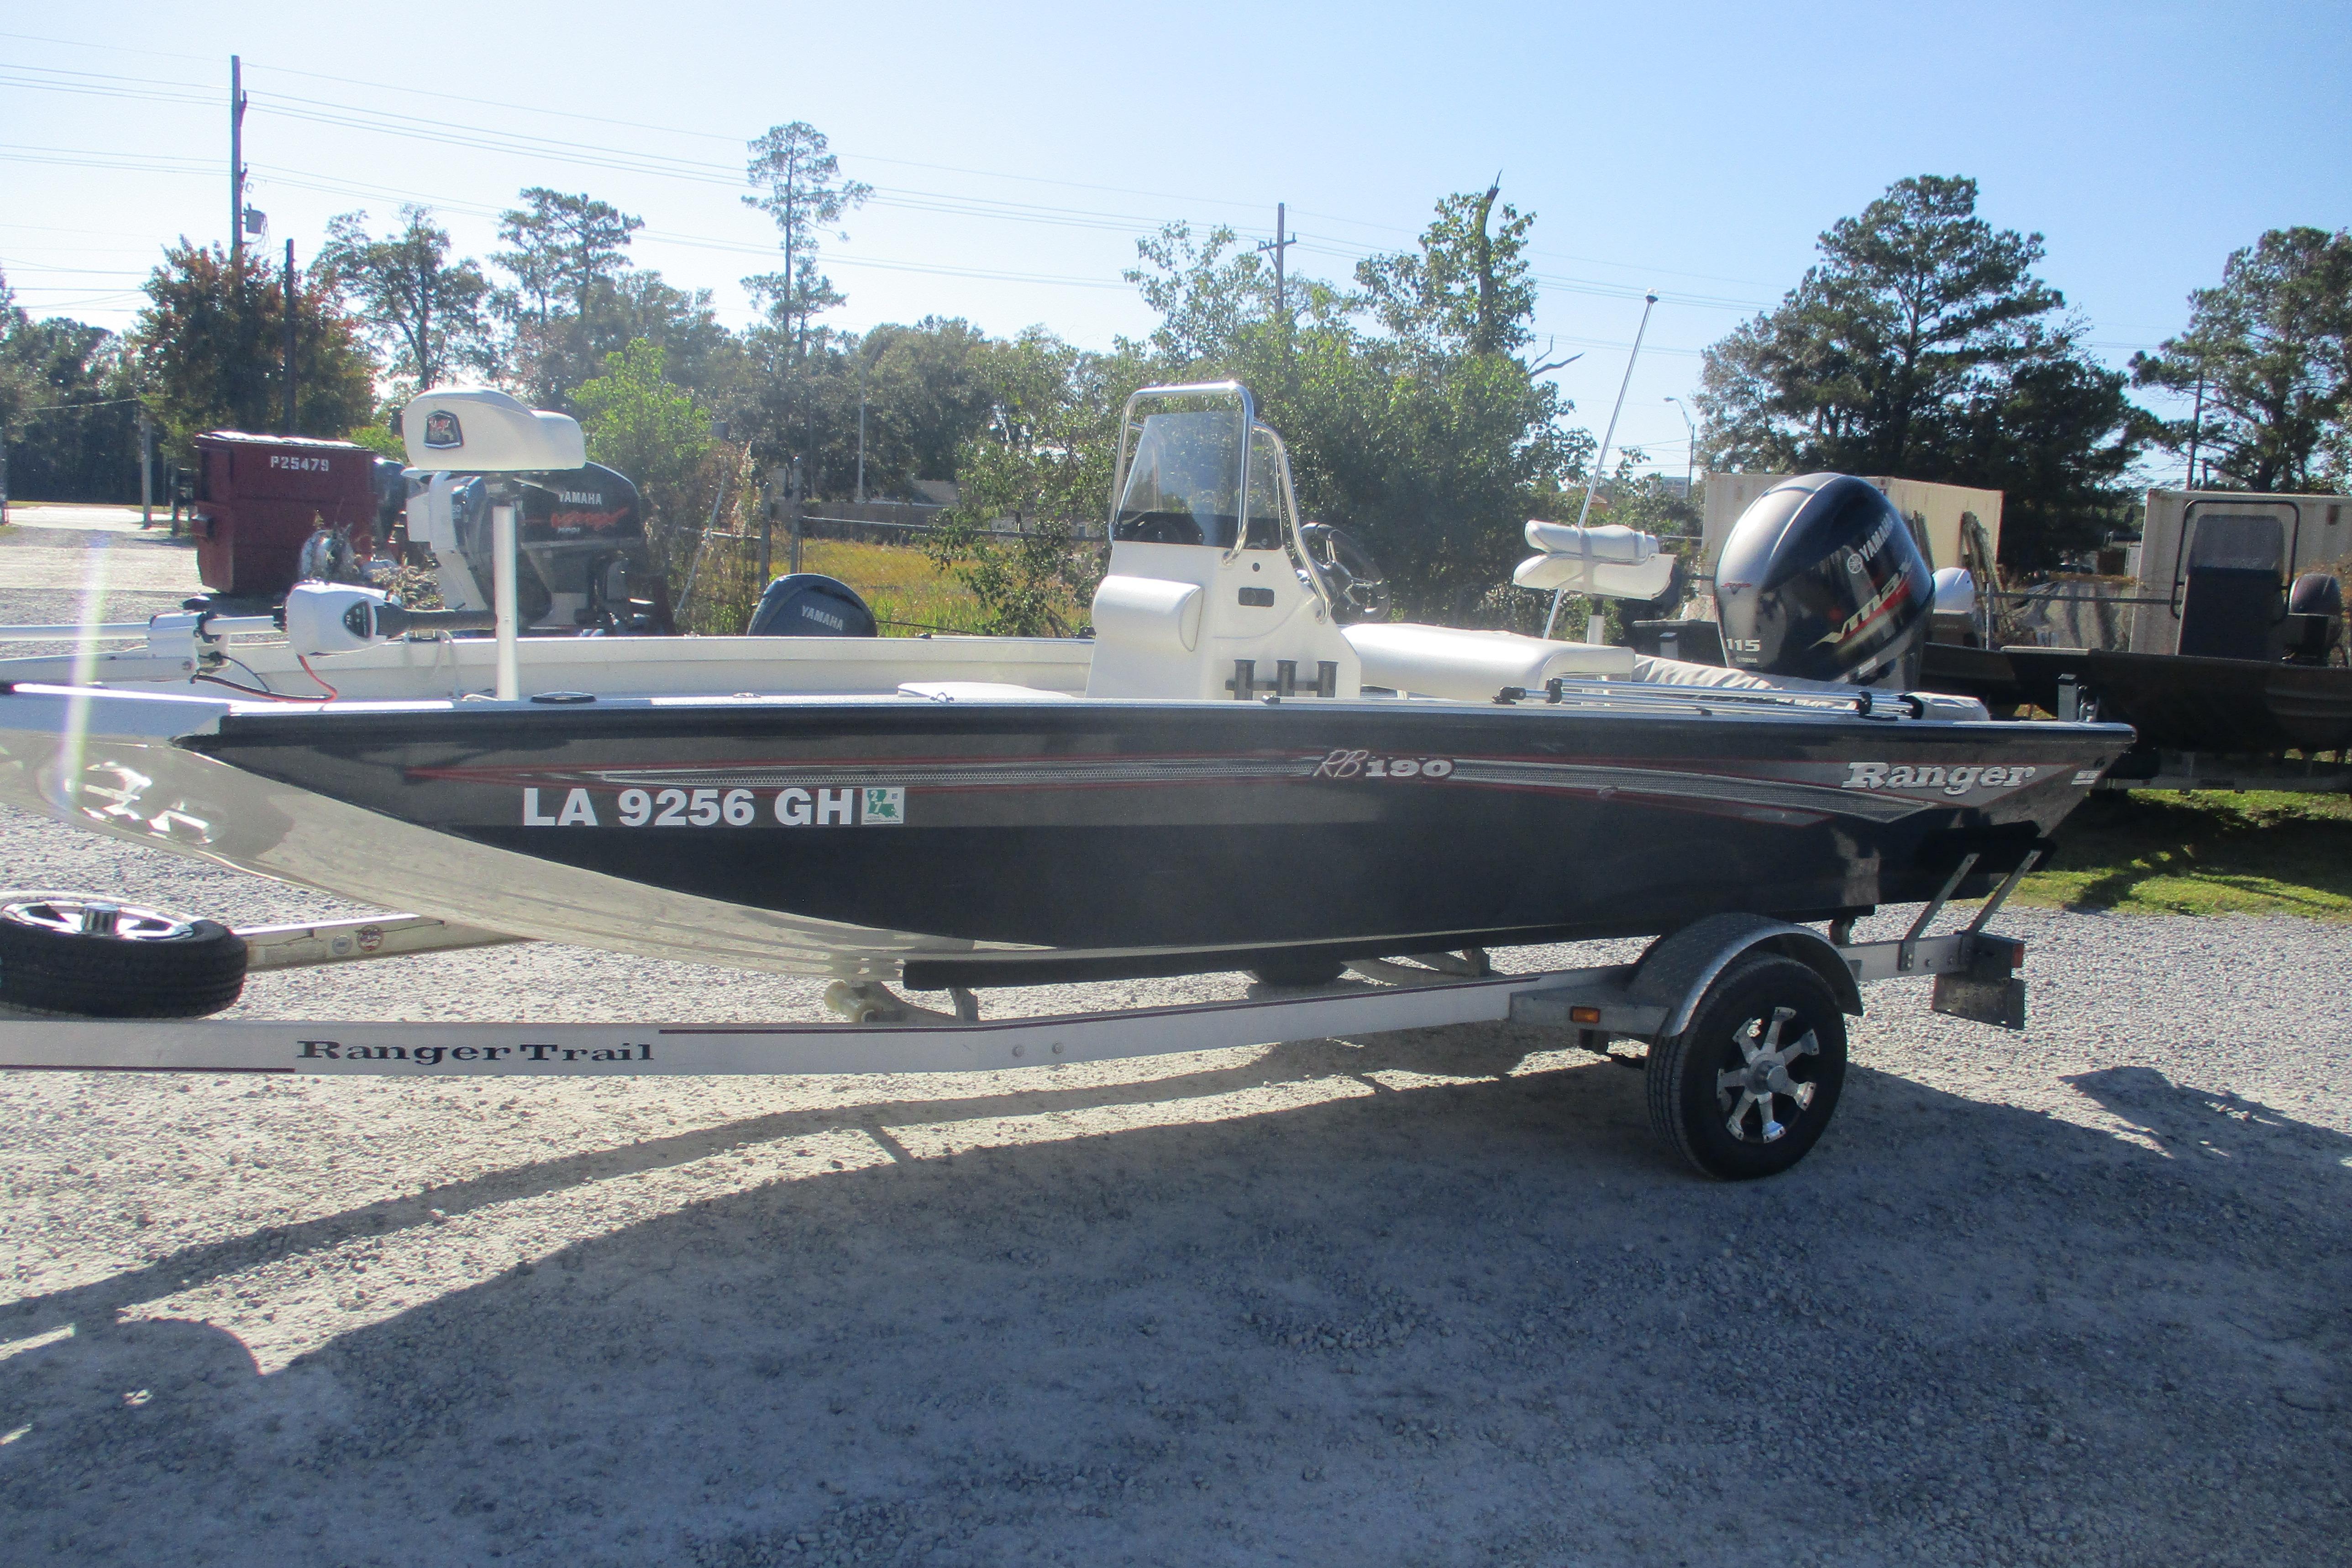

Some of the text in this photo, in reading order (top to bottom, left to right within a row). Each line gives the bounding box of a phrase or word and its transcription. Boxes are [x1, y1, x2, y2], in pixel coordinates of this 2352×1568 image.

[271, 456, 329, 472] P25479
[559, 491, 603, 505] YAMAHA
[802, 605, 843, 631] YAMAHA
[1727, 638, 1760, 652] 115
[1365, 760, 1452, 777] 190
[1841, 762, 2036, 796] Ranger
[524, 788, 854, 826] LA 9256 GH
[297, 1040, 655, 1066] Ranger Trail
